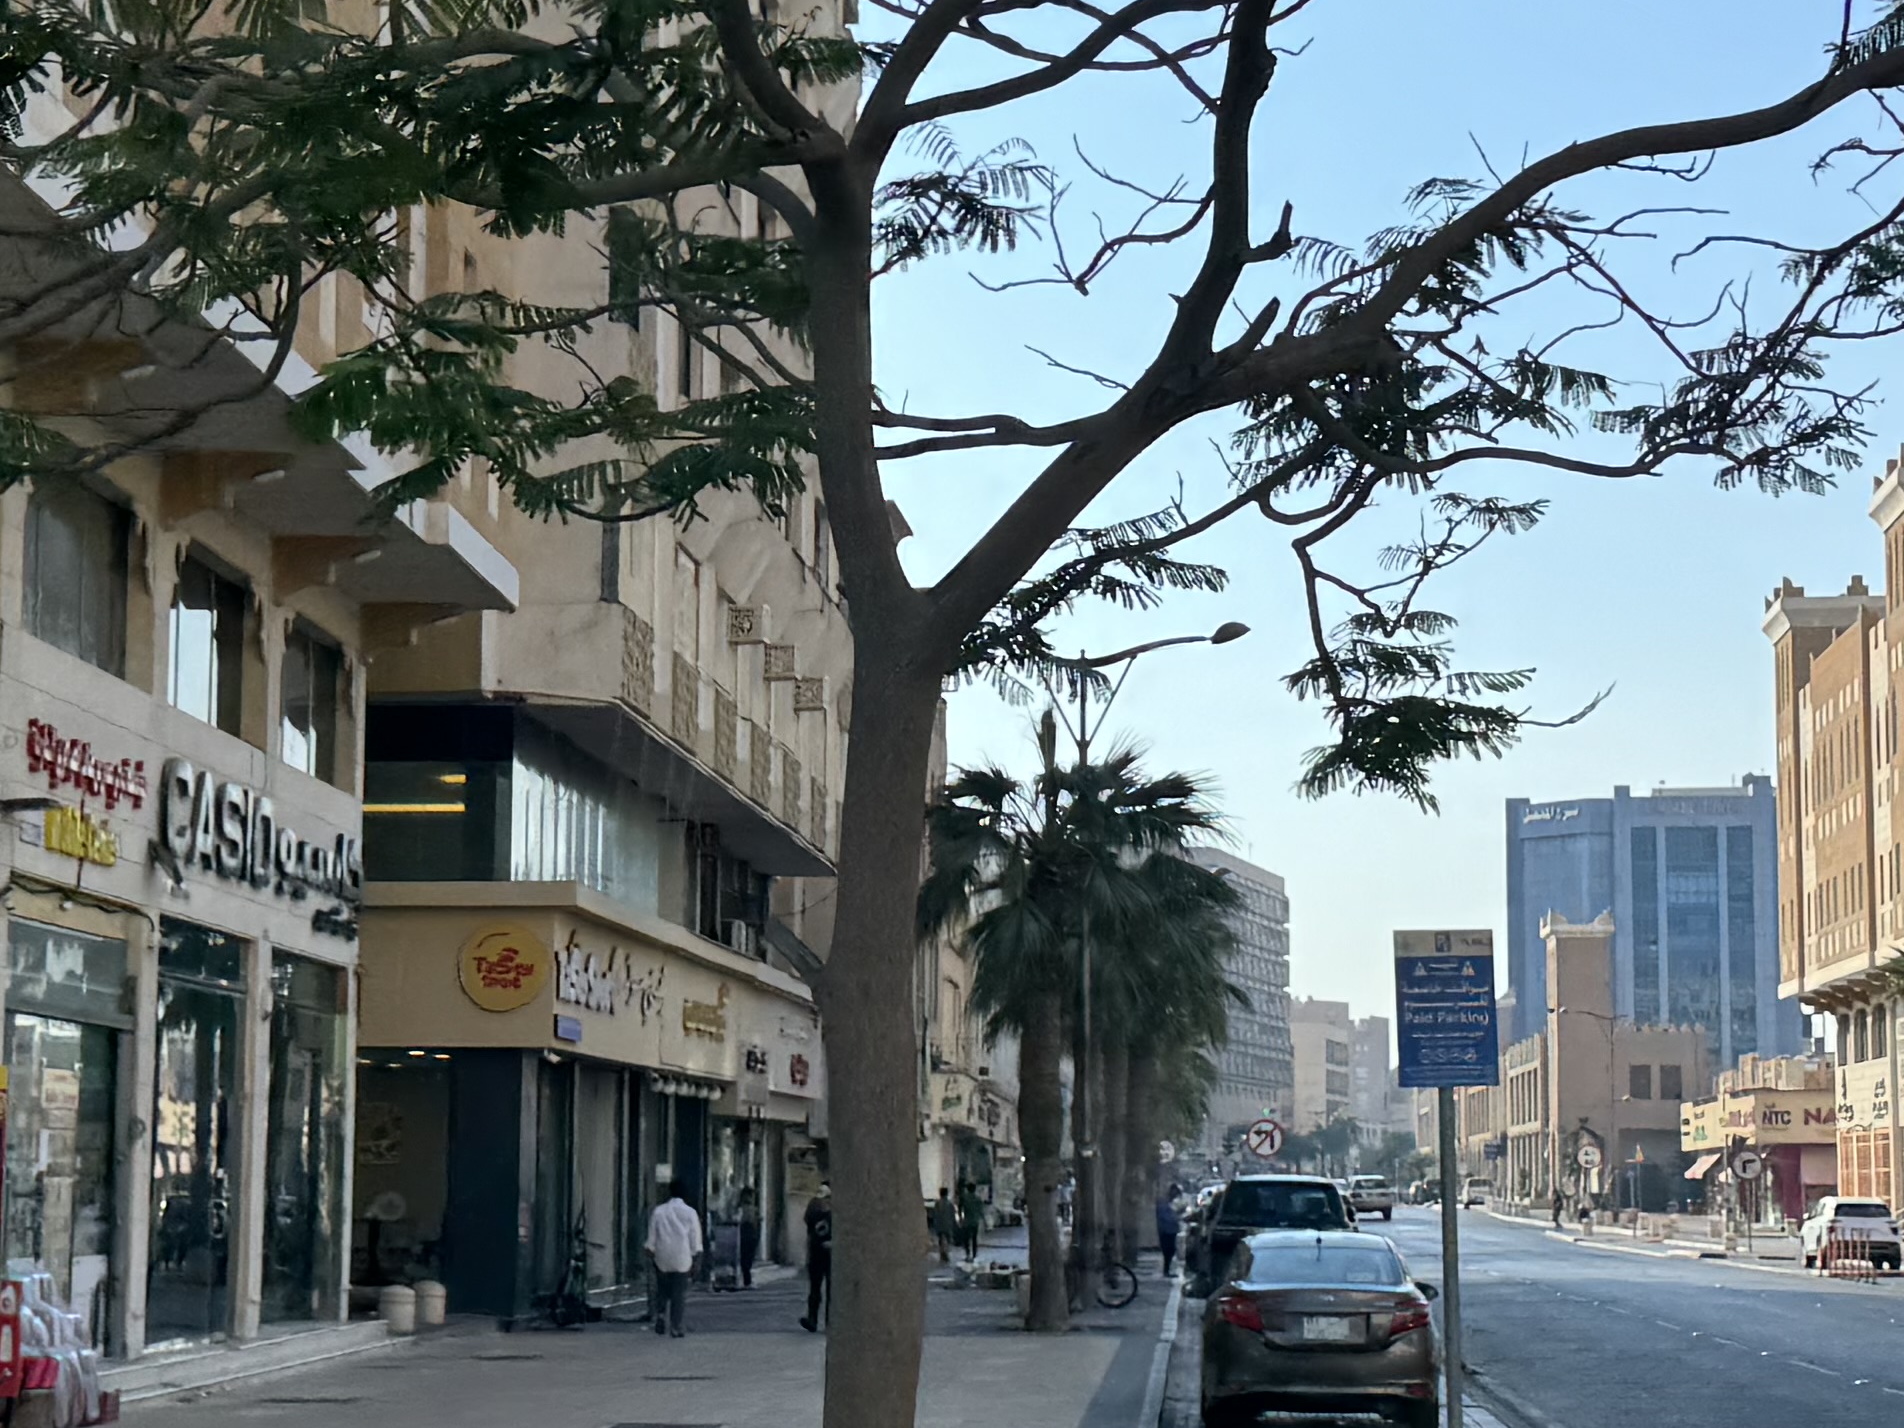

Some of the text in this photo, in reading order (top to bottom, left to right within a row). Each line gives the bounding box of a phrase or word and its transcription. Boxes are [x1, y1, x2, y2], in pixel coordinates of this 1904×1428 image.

[159, 756, 277, 889] CASIO
[1404, 1010, 1490, 1026] Paid Parking
